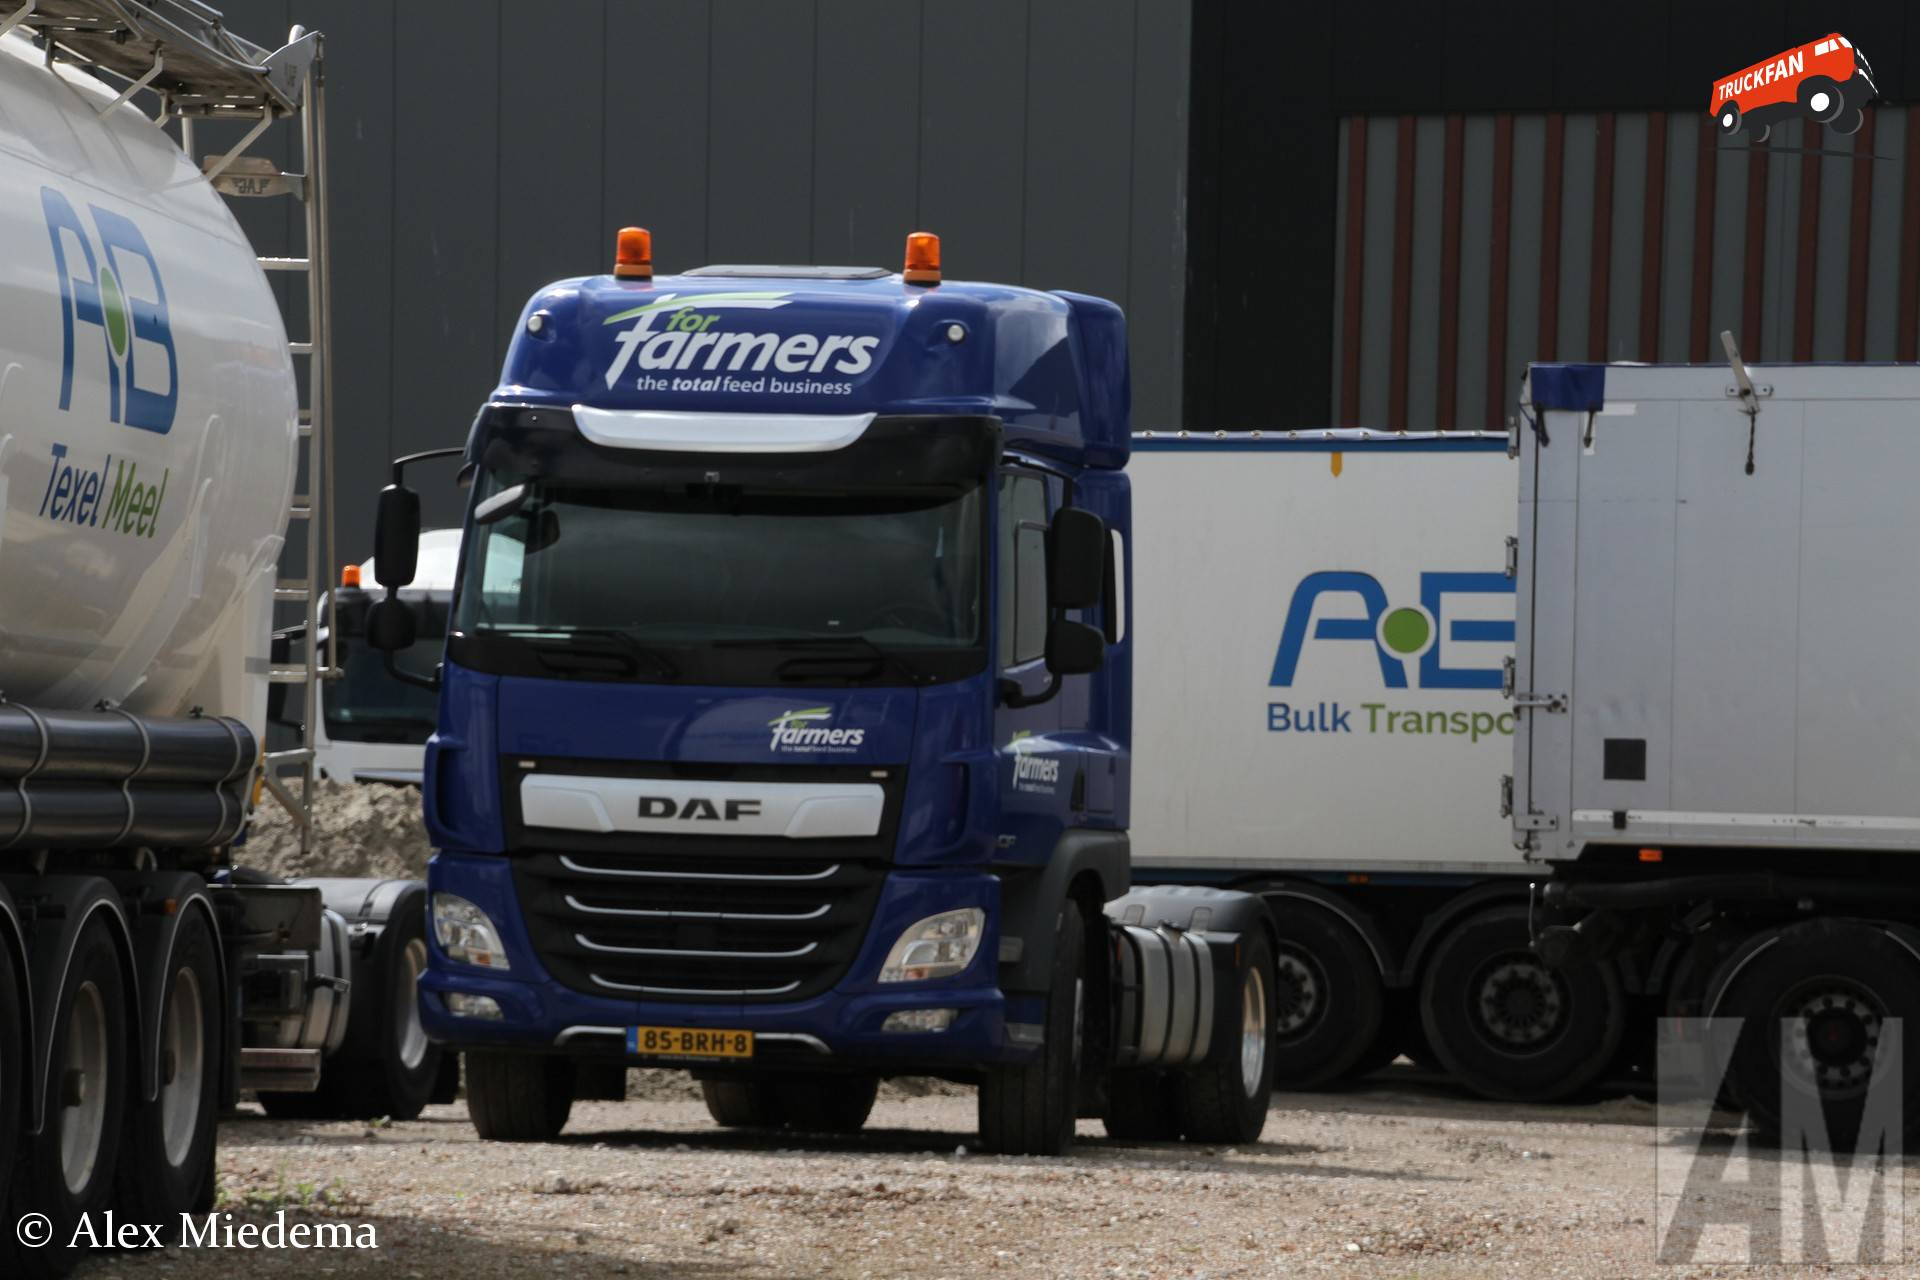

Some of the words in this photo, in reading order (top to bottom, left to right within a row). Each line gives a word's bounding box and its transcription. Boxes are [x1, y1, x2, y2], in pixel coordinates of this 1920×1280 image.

[41, 186, 179, 435] AB
[666, 306, 720, 332] for
[603, 292, 880, 390] farmers
[637, 375, 668, 391] the
[671, 376, 721, 392] total
[722, 376, 766, 393] feed
[769, 377, 852, 395] business
[38, 443, 111, 527] Texel
[102, 459, 169, 538] Meel
[769, 709, 865, 752] farmers
[1267, 702, 1352, 732] Bulk
[638, 796, 761, 821] DAF
[644, 1029, 748, 1053] 85-BRH-8
